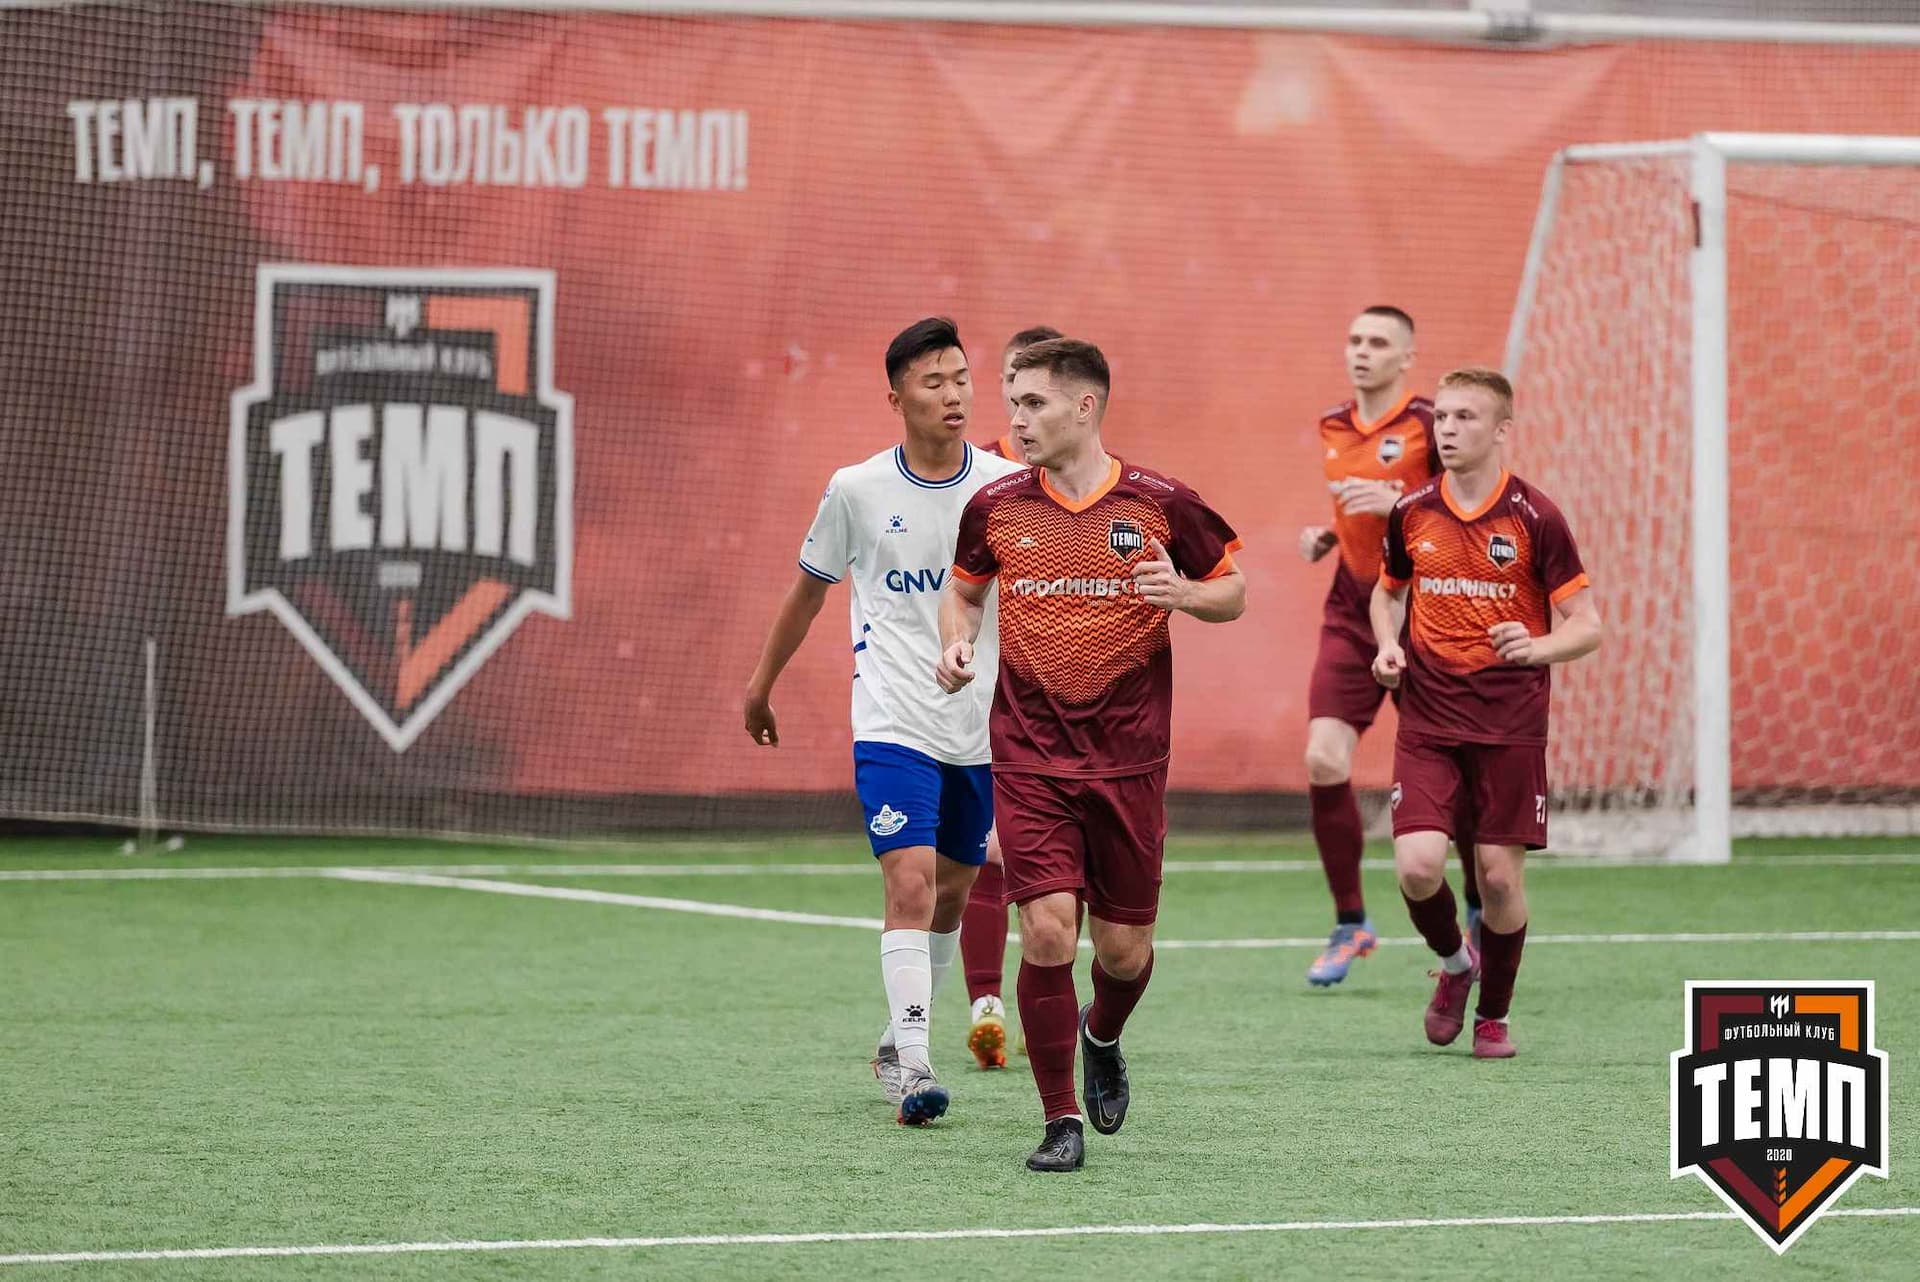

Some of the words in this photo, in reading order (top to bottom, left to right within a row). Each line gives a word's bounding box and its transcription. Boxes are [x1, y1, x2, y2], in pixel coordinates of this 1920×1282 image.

[67, 98, 214, 188] ТЕМП,
[229, 99, 380, 193] ТЕМП,
[394, 104, 590, 188] ТОЛЬКО
[604, 108, 749, 191] ТЕМП!
[269, 402, 540, 567] ТЕМП
[1111, 532, 1141, 547] ТЕМП
[886, 568, 946, 593] GNV
